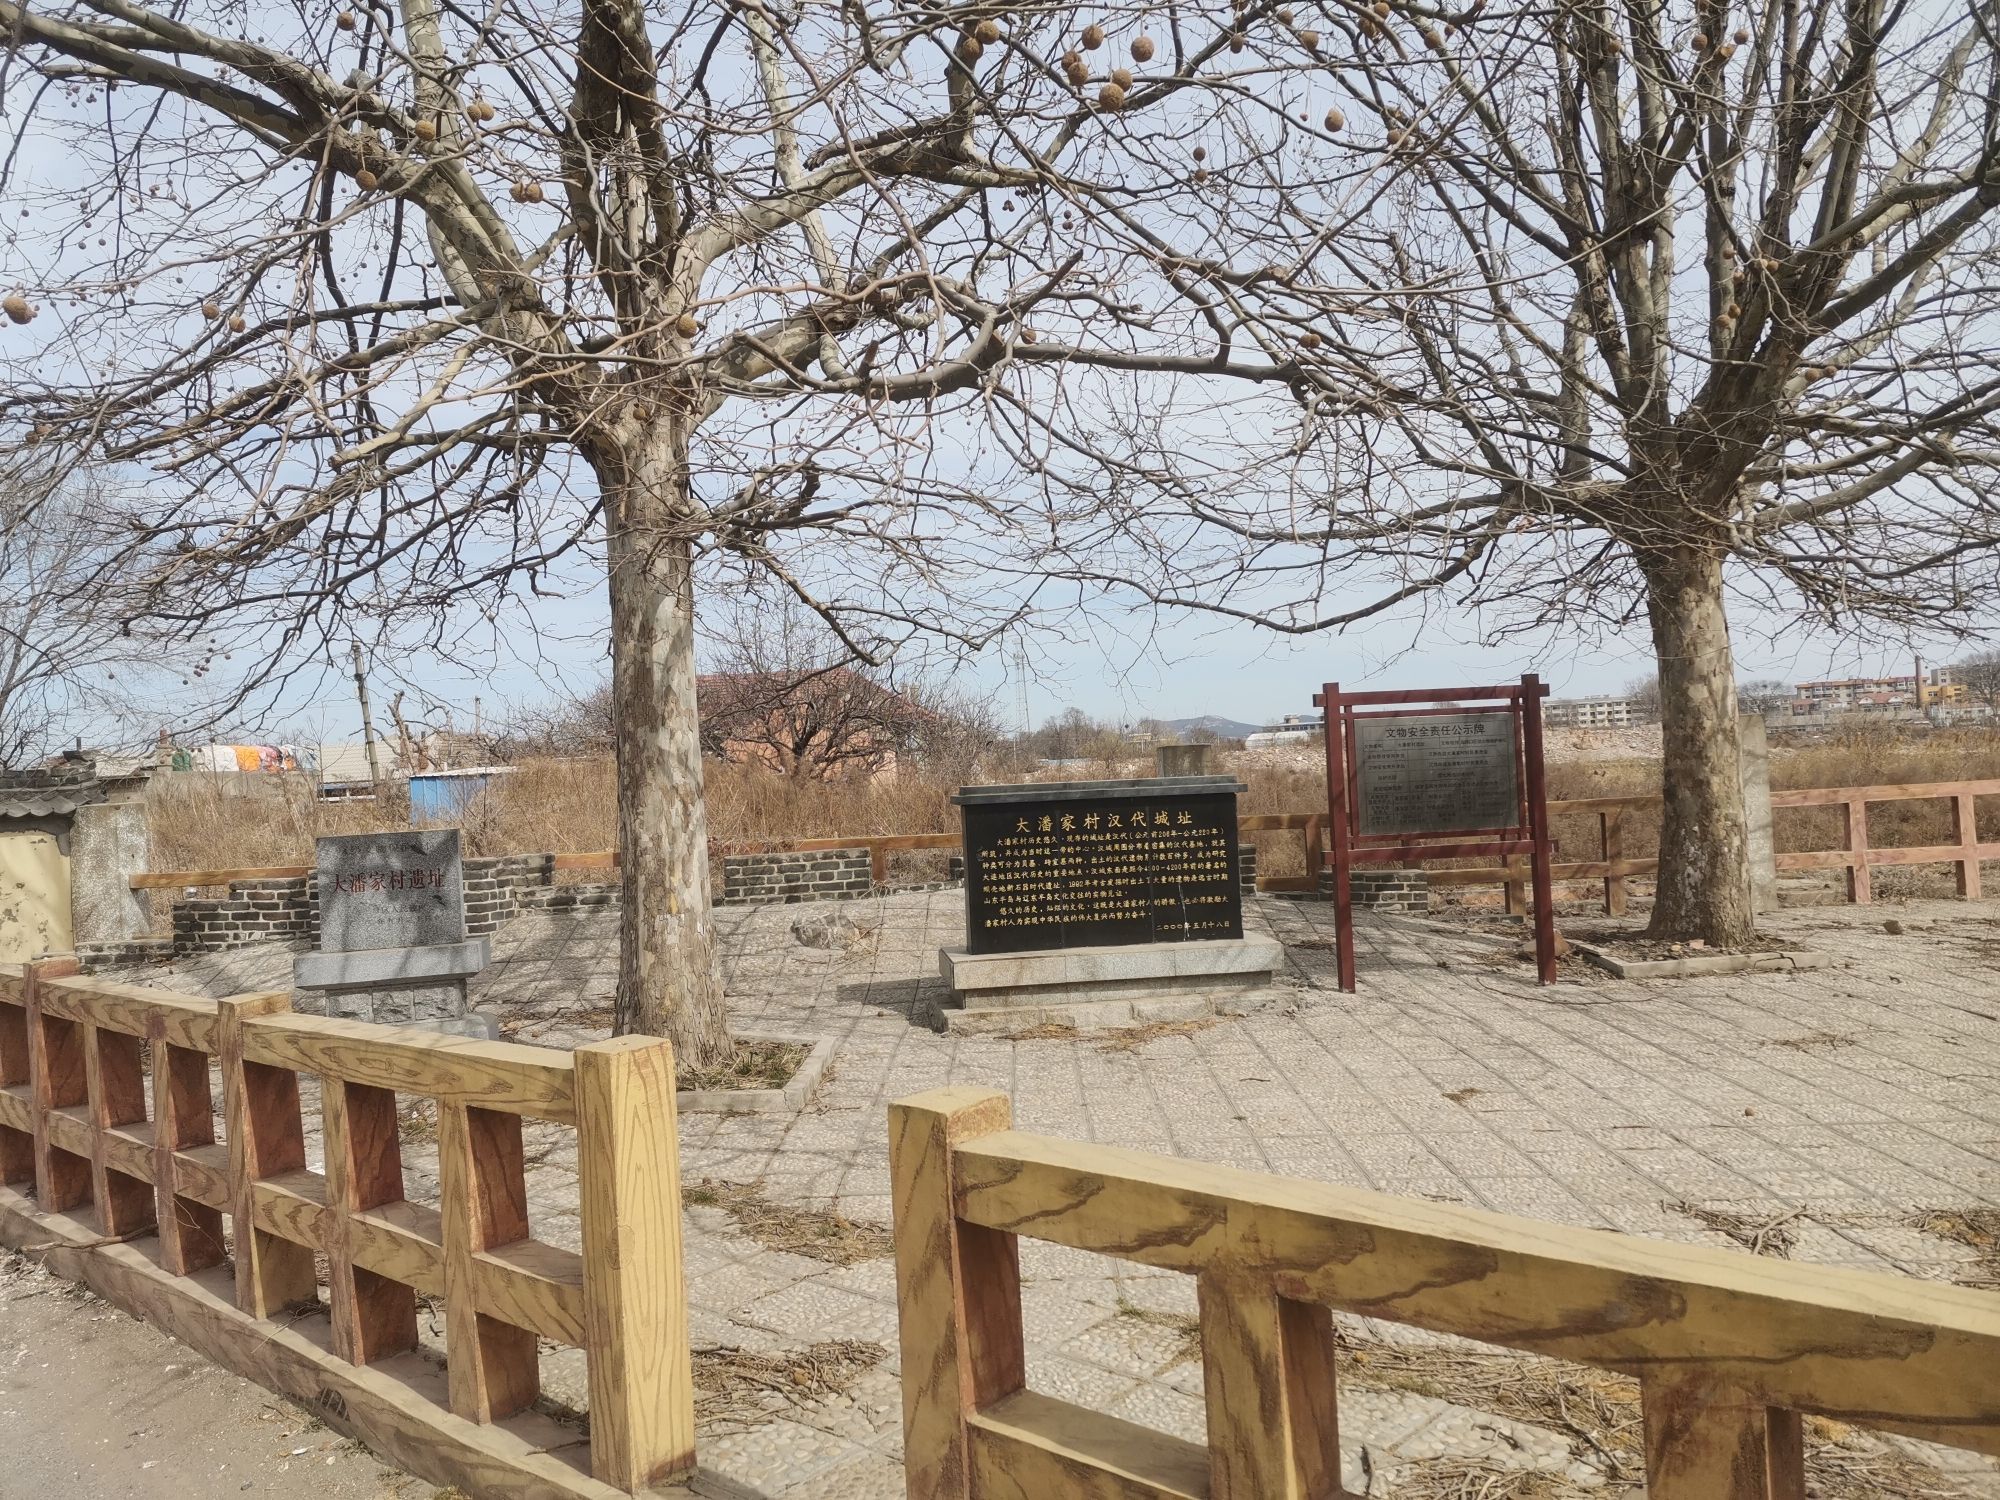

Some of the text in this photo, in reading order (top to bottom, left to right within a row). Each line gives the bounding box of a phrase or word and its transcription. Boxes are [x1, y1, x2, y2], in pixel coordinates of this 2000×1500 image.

[1385, 723, 1486, 738] 文物安全责任公示牌
[1015, 810, 1193, 833] 大潘家村汉代城址
[330, 867, 445, 894] 大潘家村遗址
